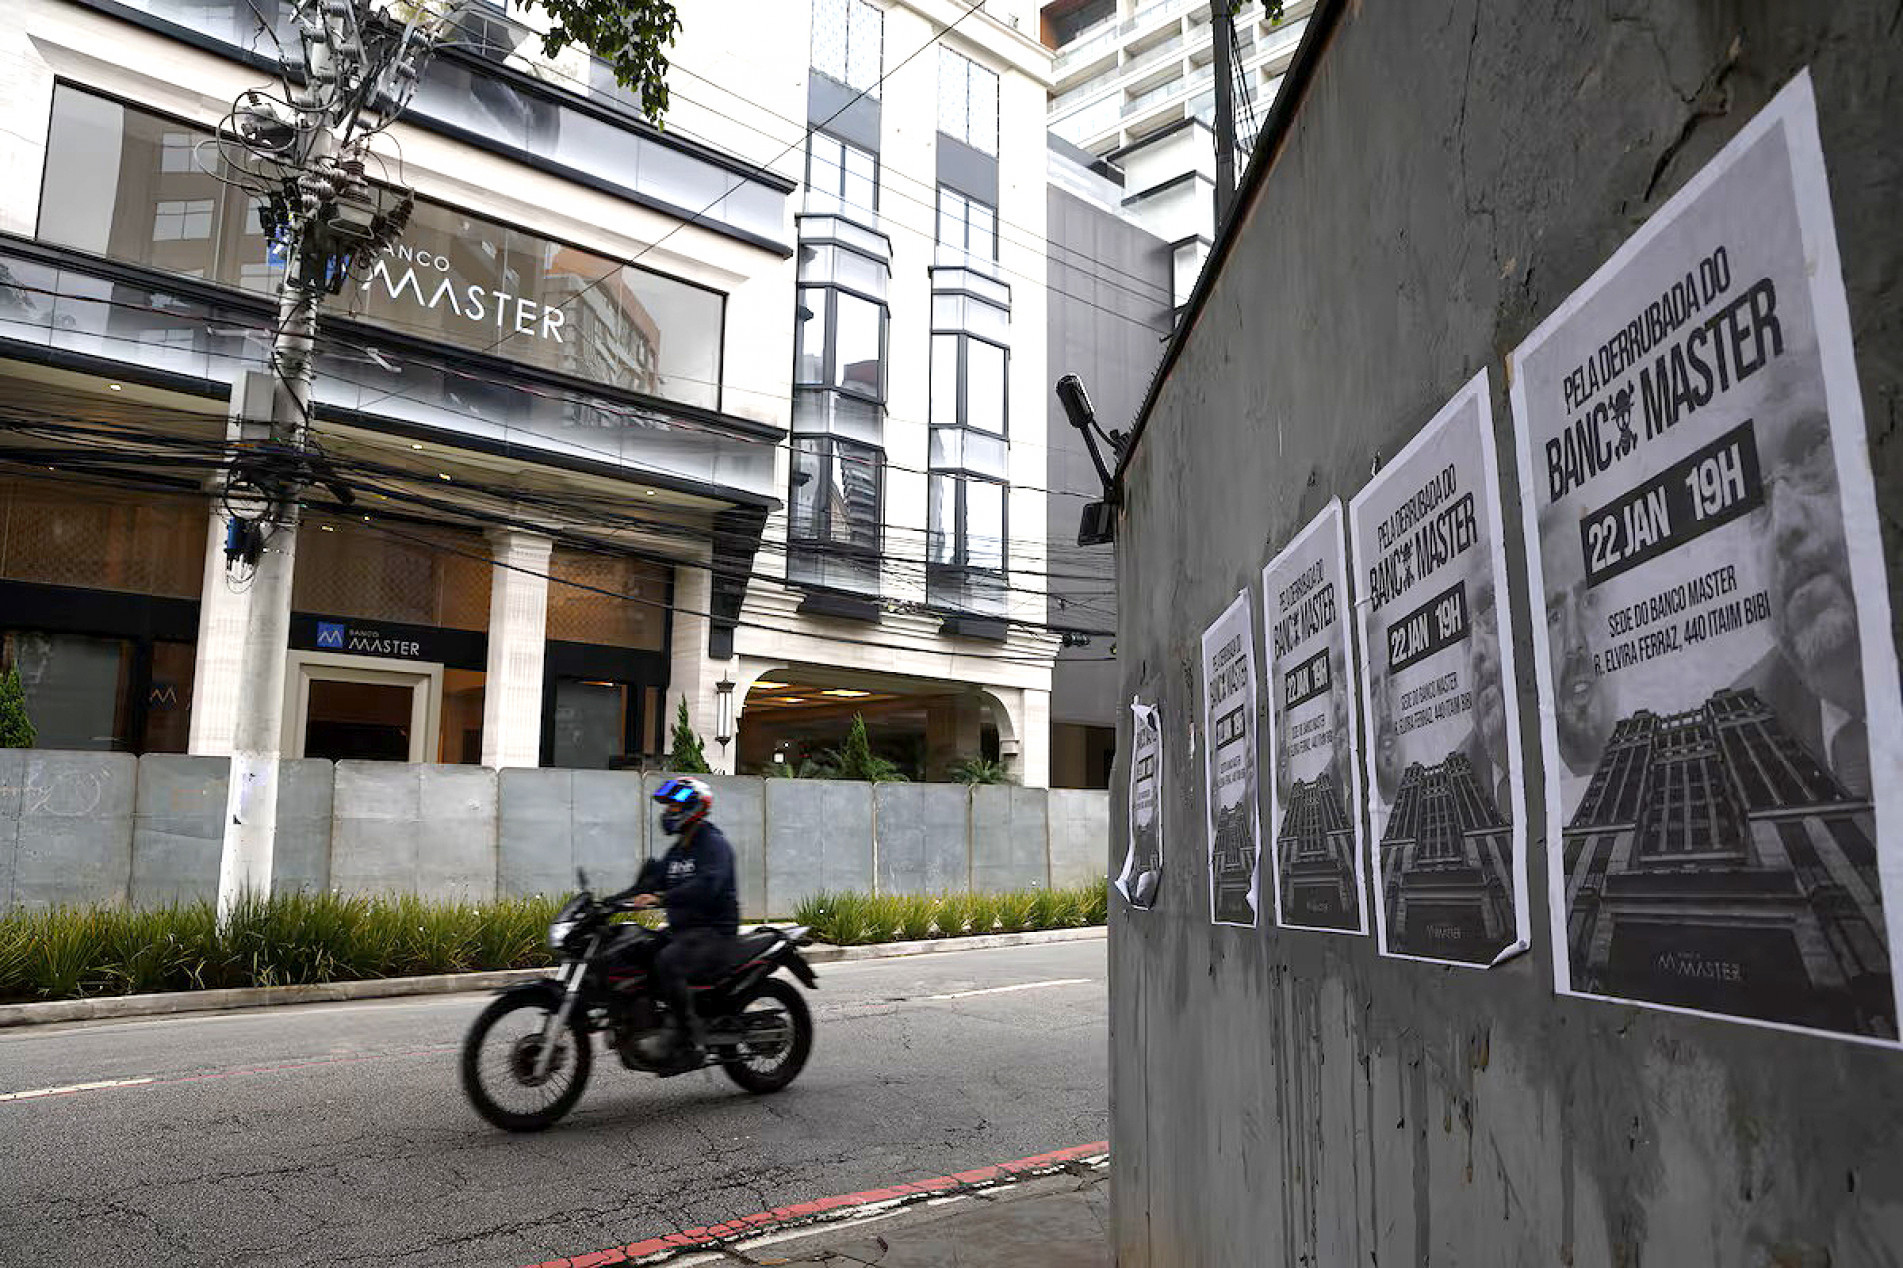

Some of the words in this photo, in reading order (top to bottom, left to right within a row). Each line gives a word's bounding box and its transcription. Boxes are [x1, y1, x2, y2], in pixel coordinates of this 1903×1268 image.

[382, 242, 450, 272] ANCO
[361, 259, 564, 343] MASTER
[1563, 354, 1600, 415] PELA
[1598, 271, 1701, 387] DERRUBADA
[1699, 245, 1731, 305] DO
[1639, 277, 1784, 441] MASTER
[1415, 491, 1478, 581] MASTER
[1587, 517, 1621, 574] 22
[1623, 484, 1671, 559] JAN
[1685, 443, 1746, 520] 19H
[1391, 626, 1408, 666] 22
[1408, 613, 1431, 659] JAN
[1435, 592, 1462, 641] 19H
[1605, 639, 1639, 673] ELVIRA
[1684, 614, 1707, 646] 440
[1707, 601, 1743, 638] ITAIM
[1743, 590, 1771, 625] BIBI
[1607, 605, 1635, 638] SEDE
[1634, 601, 1649, 629] DO
[1650, 585, 1686, 622] BANCO
[1687, 564, 1738, 608] MASTER
[348, 637, 420, 656] MASTER
